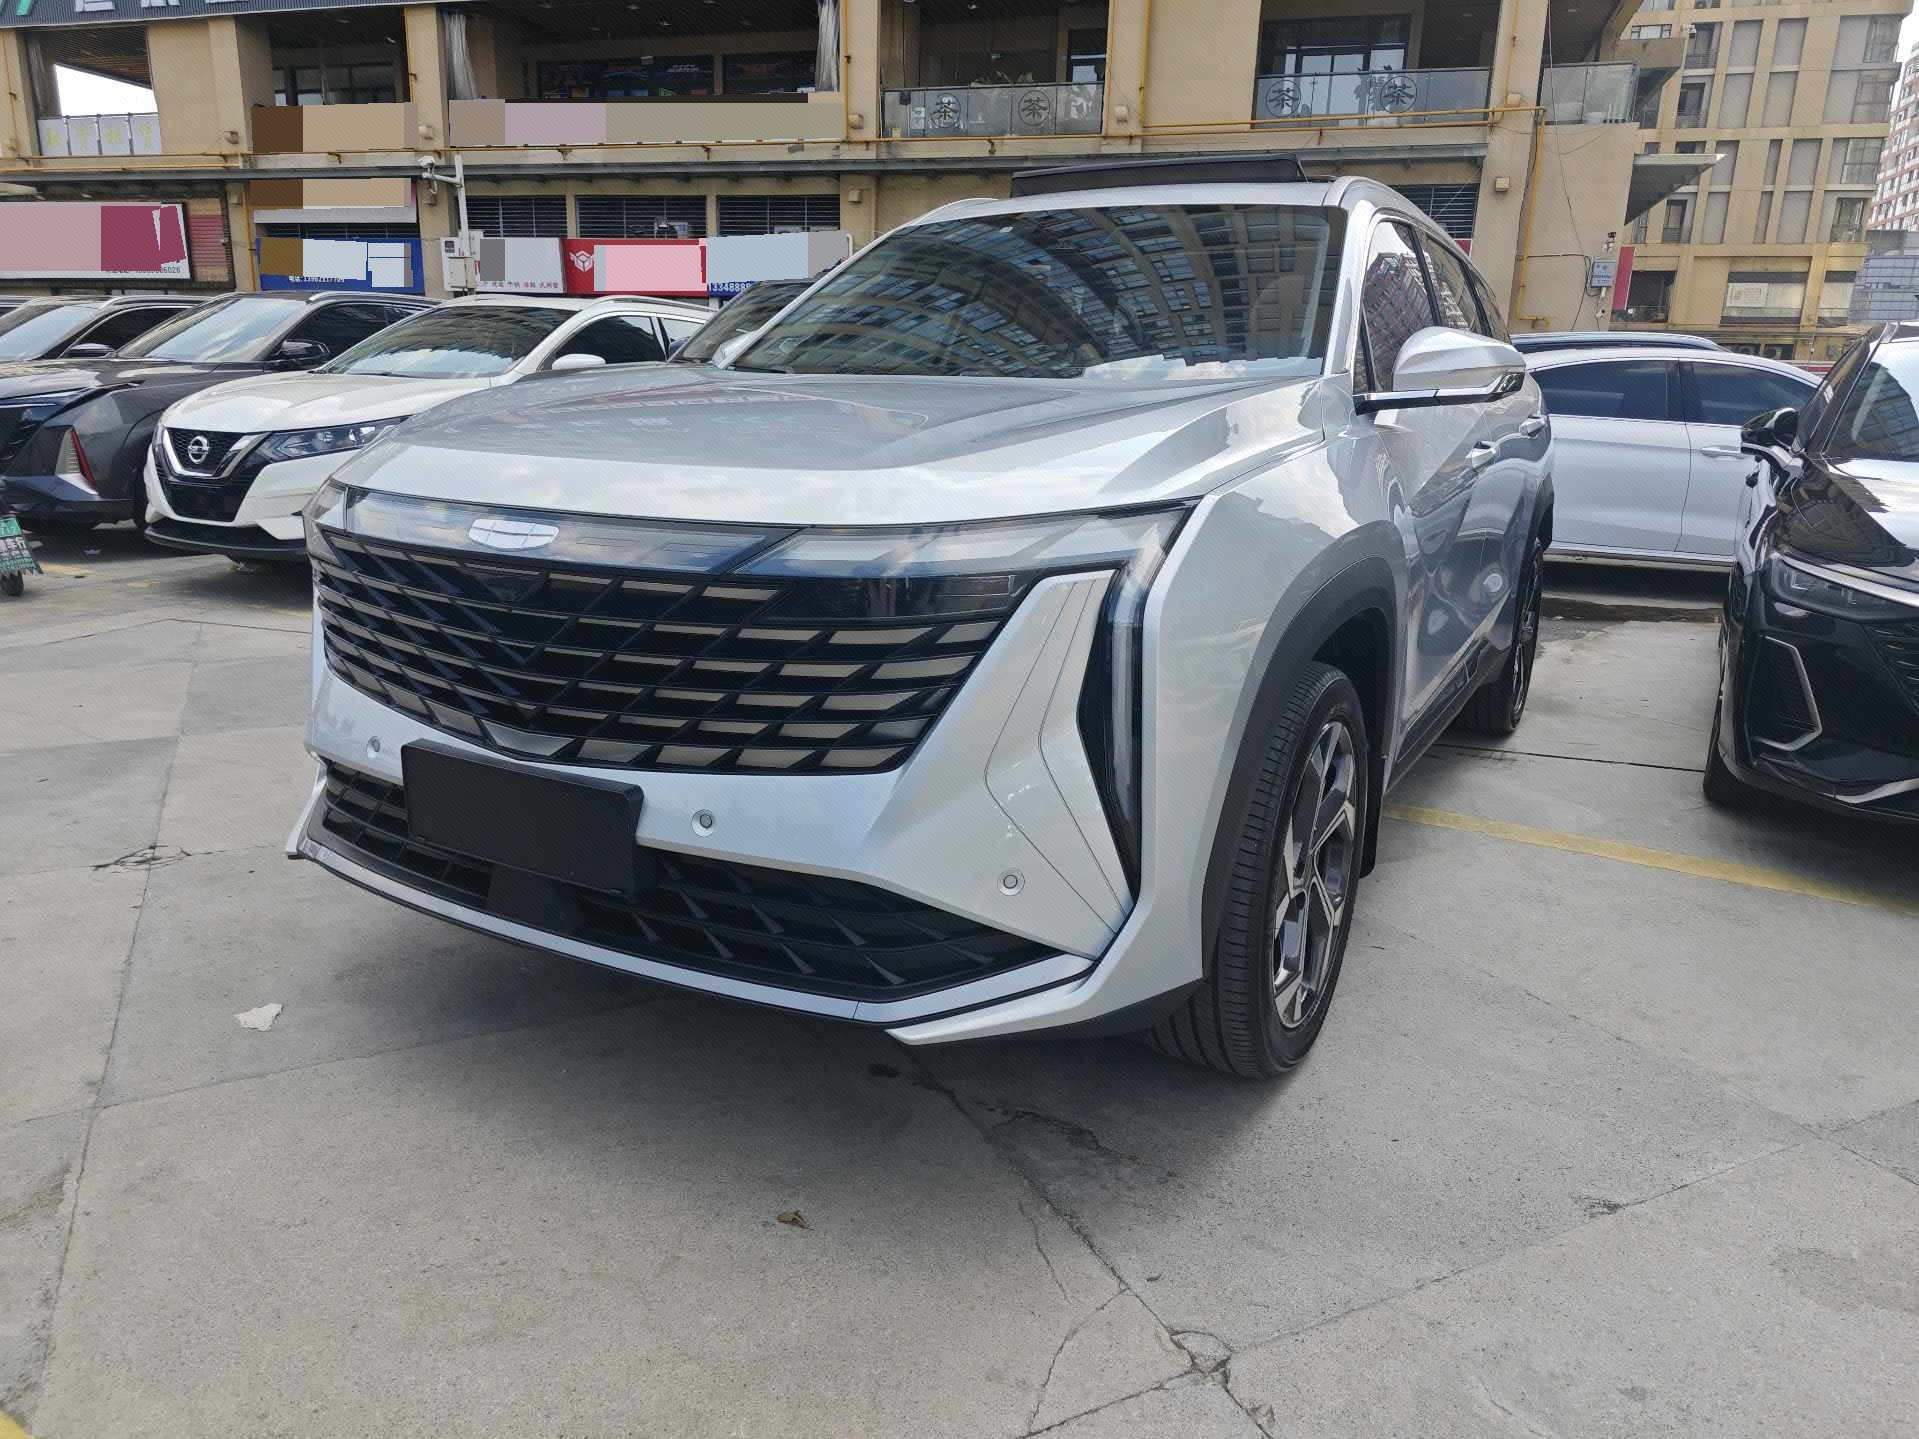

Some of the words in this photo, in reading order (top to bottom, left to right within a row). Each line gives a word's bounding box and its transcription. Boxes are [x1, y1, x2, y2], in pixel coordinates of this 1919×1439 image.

[1268, 88, 1298, 109] 茶
[1383, 83, 1414, 105] 茶
[1021, 96, 1049, 118] 茶
